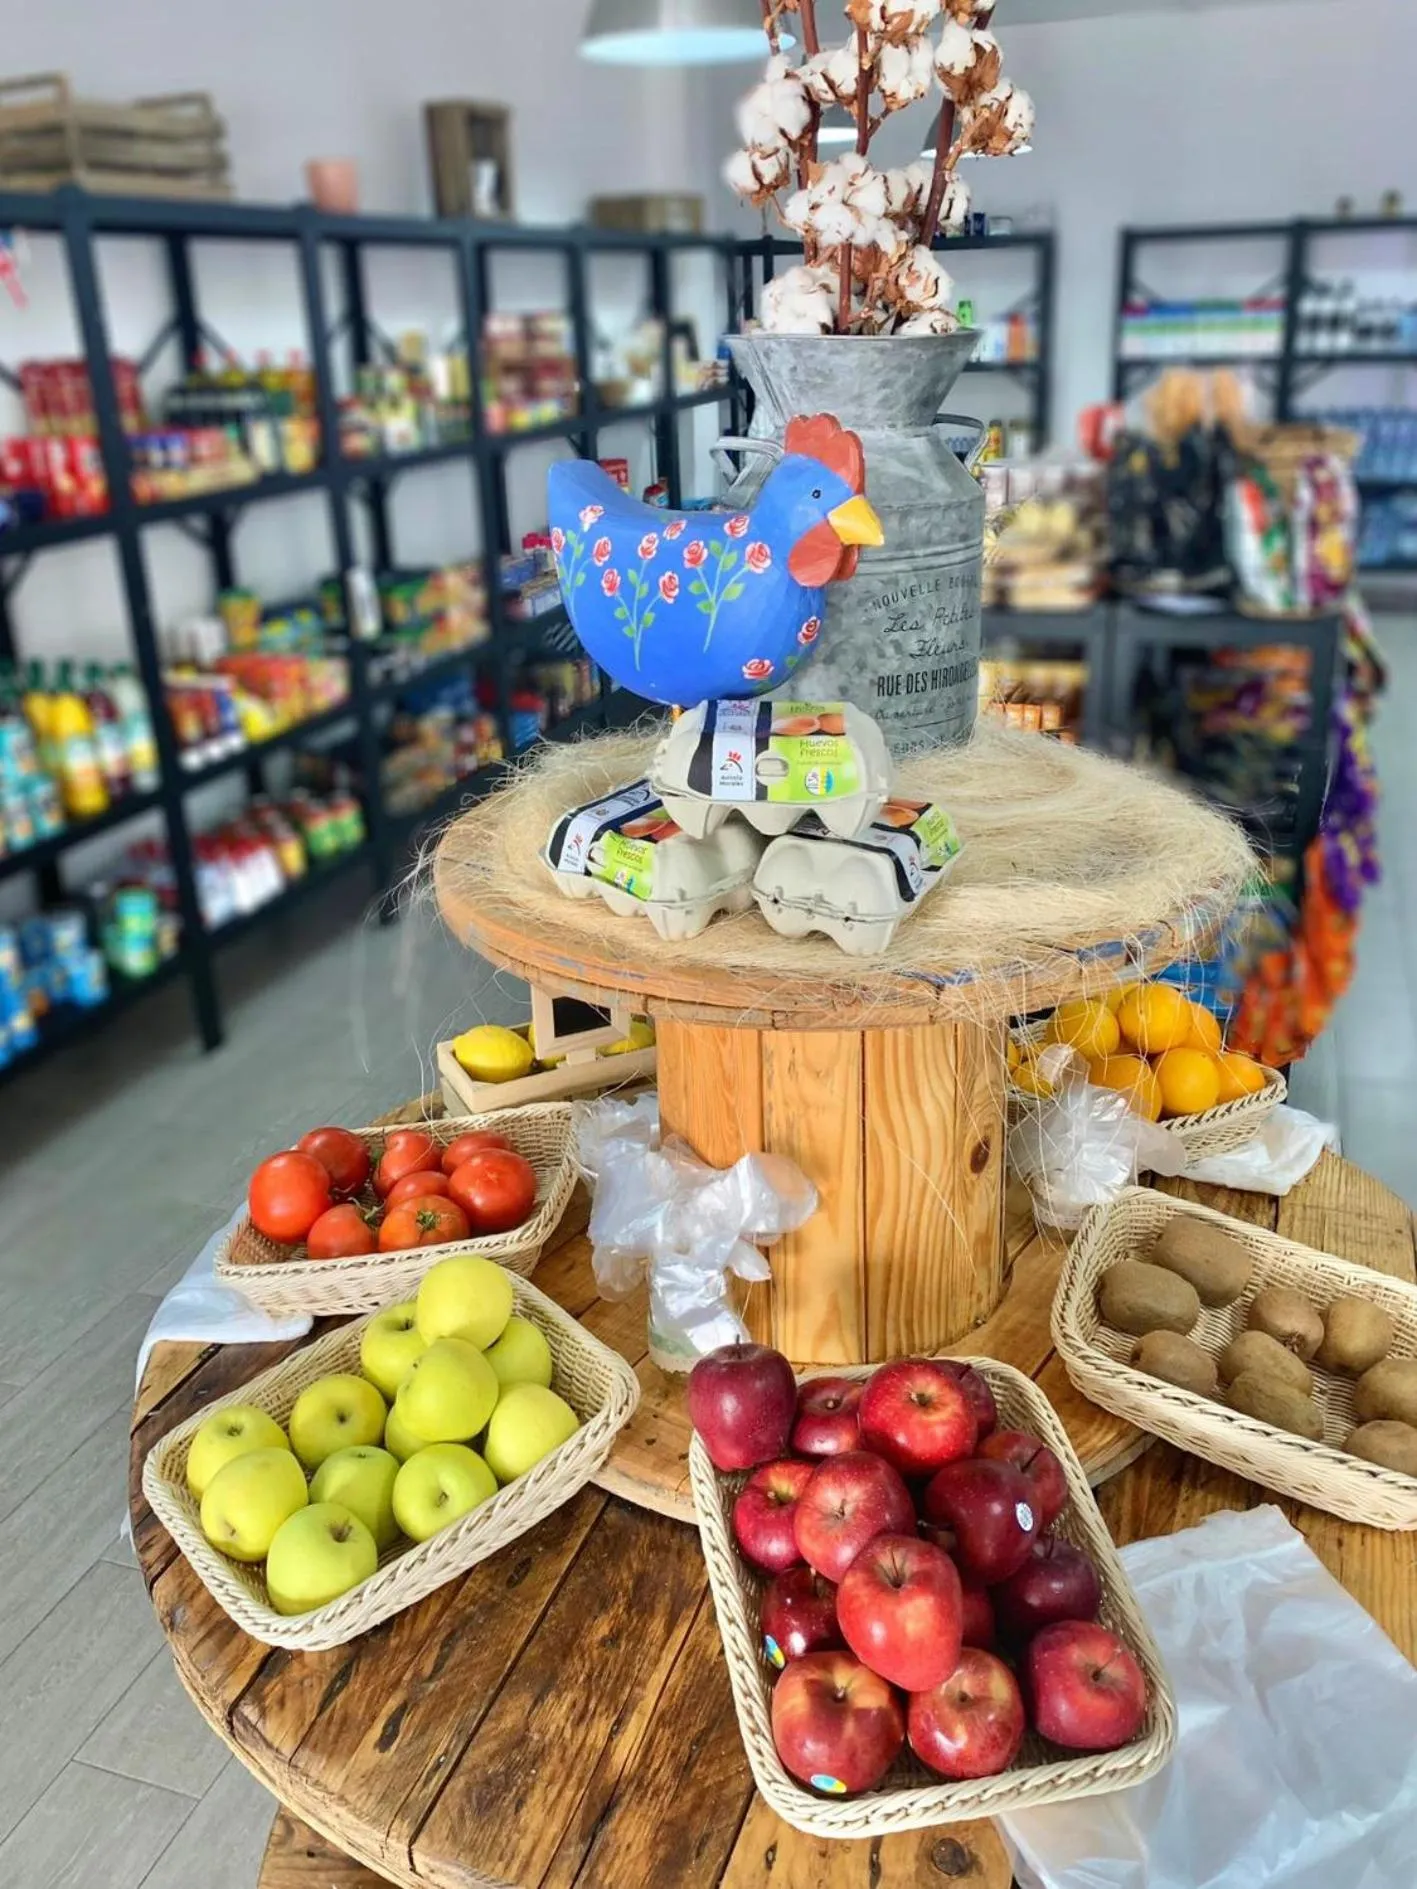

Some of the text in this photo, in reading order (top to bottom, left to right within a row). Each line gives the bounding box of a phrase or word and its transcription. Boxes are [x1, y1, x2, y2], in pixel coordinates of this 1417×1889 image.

[872, 578, 941, 612] NOUVELLE
[884, 612, 924, 633] Les
[877, 673, 902, 697] RUE
[906, 670, 928, 695] DES
